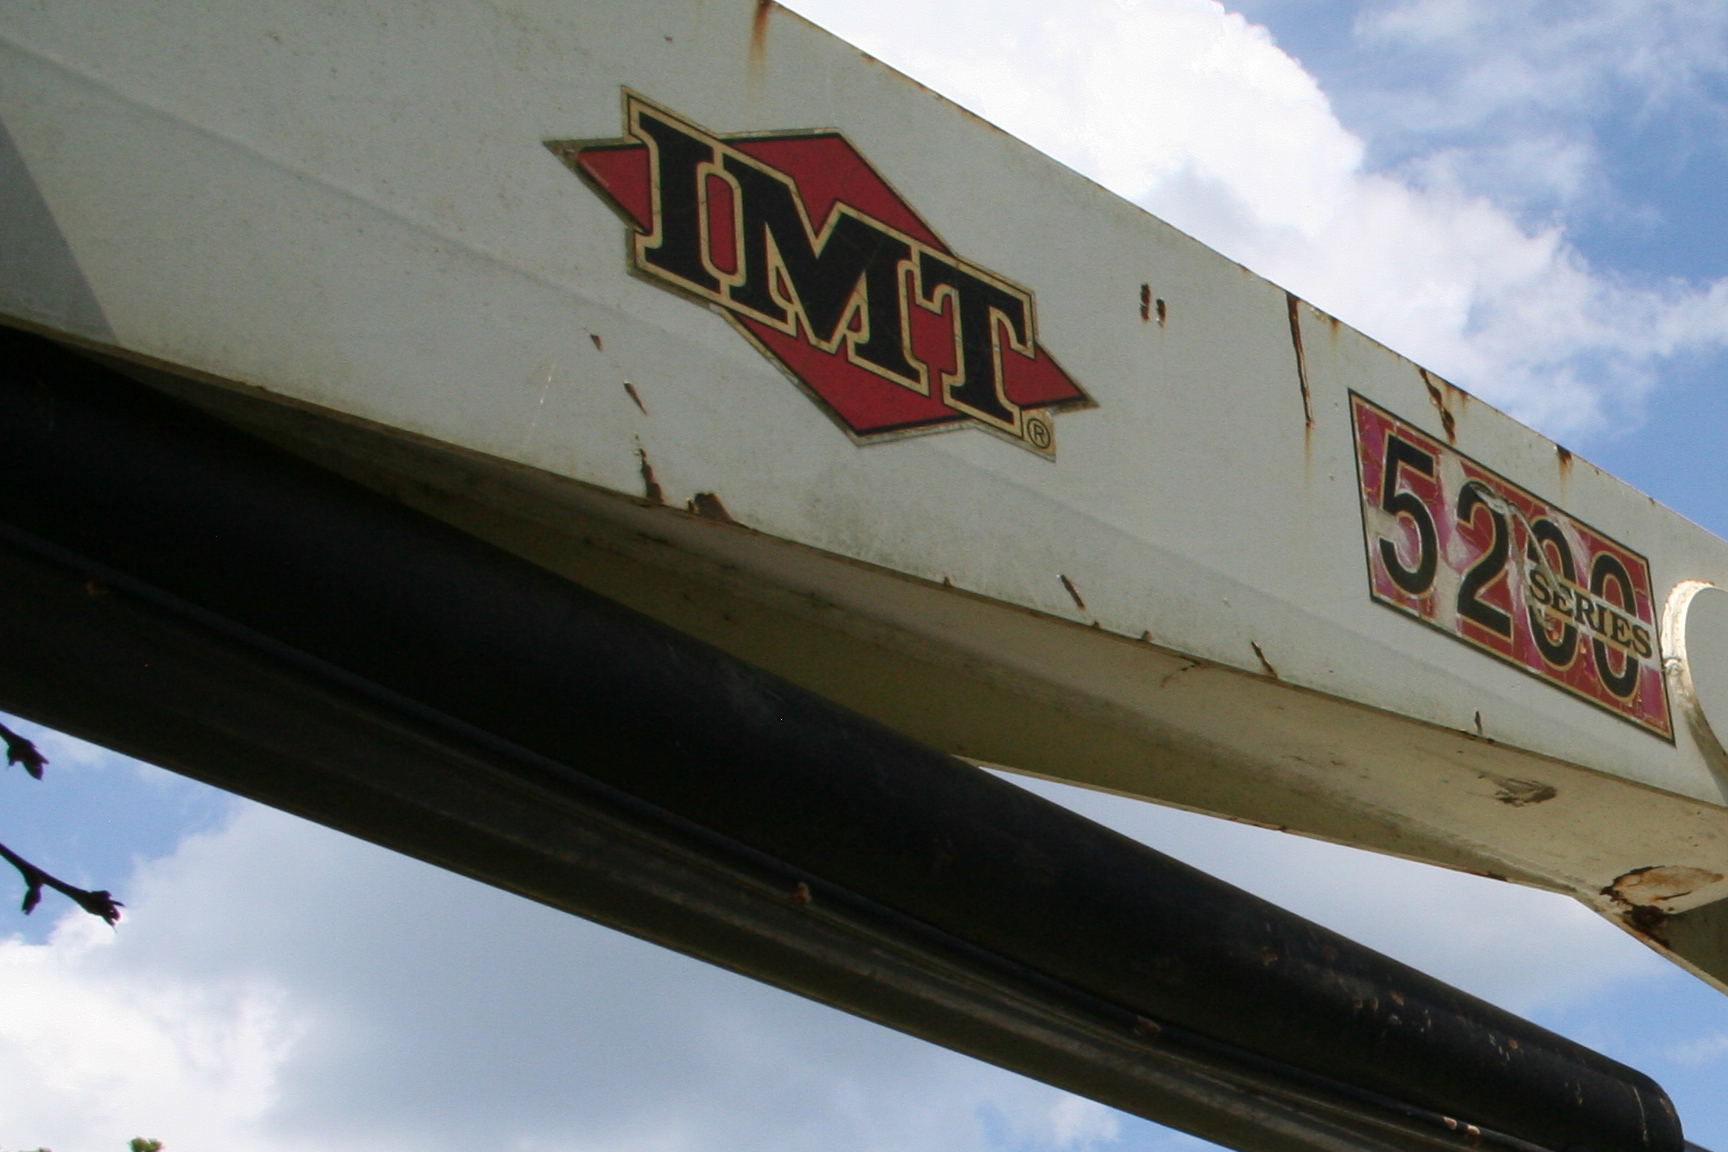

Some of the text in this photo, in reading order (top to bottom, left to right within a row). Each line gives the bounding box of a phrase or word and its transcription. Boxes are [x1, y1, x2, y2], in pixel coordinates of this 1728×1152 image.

[634, 104, 1034, 432] IMT
[1377, 431, 1641, 699] 5200
[1528, 568, 1653, 660] SERIES
